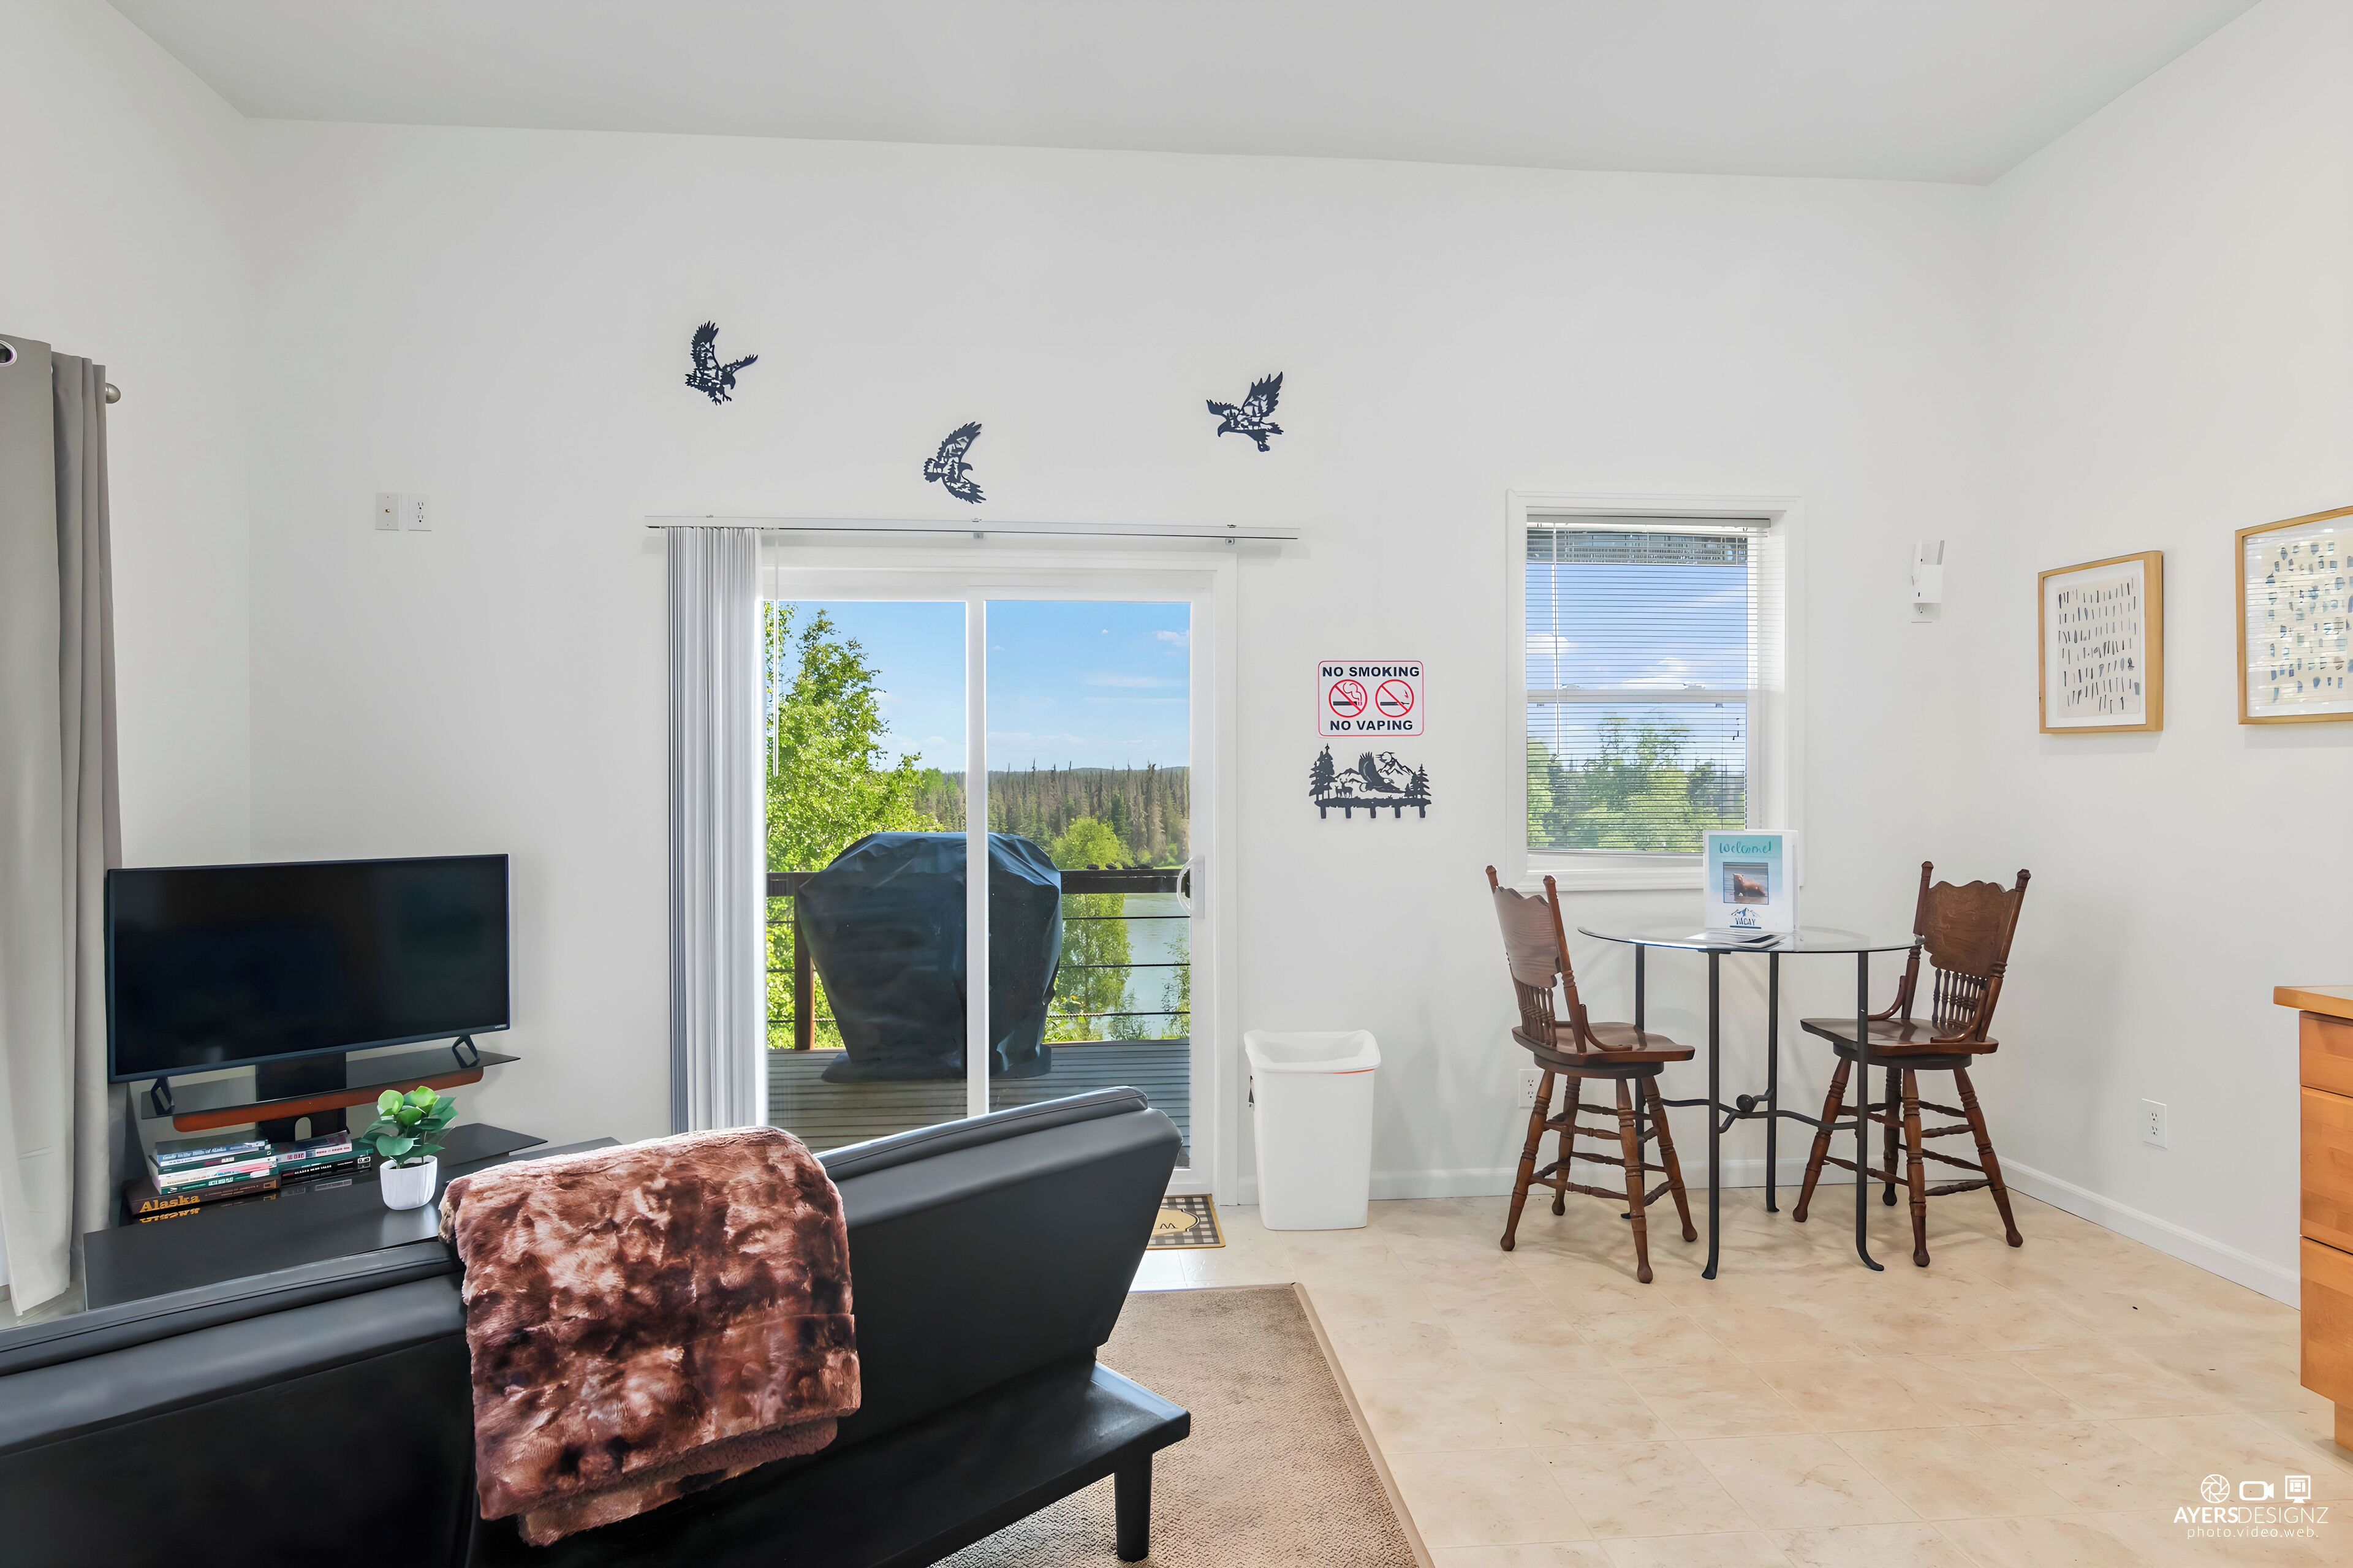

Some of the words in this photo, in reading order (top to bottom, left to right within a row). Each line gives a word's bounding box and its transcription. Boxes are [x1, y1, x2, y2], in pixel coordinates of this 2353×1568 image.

[1322, 667, 1344, 676] NO
[1349, 667, 1420, 677] SMOKING
[1330, 721, 1351, 730] NO
[1357, 720, 1413, 730] VAPING
[1719, 841, 1771, 854] Welcome!
[139, 1195, 200, 1213] Alaska
